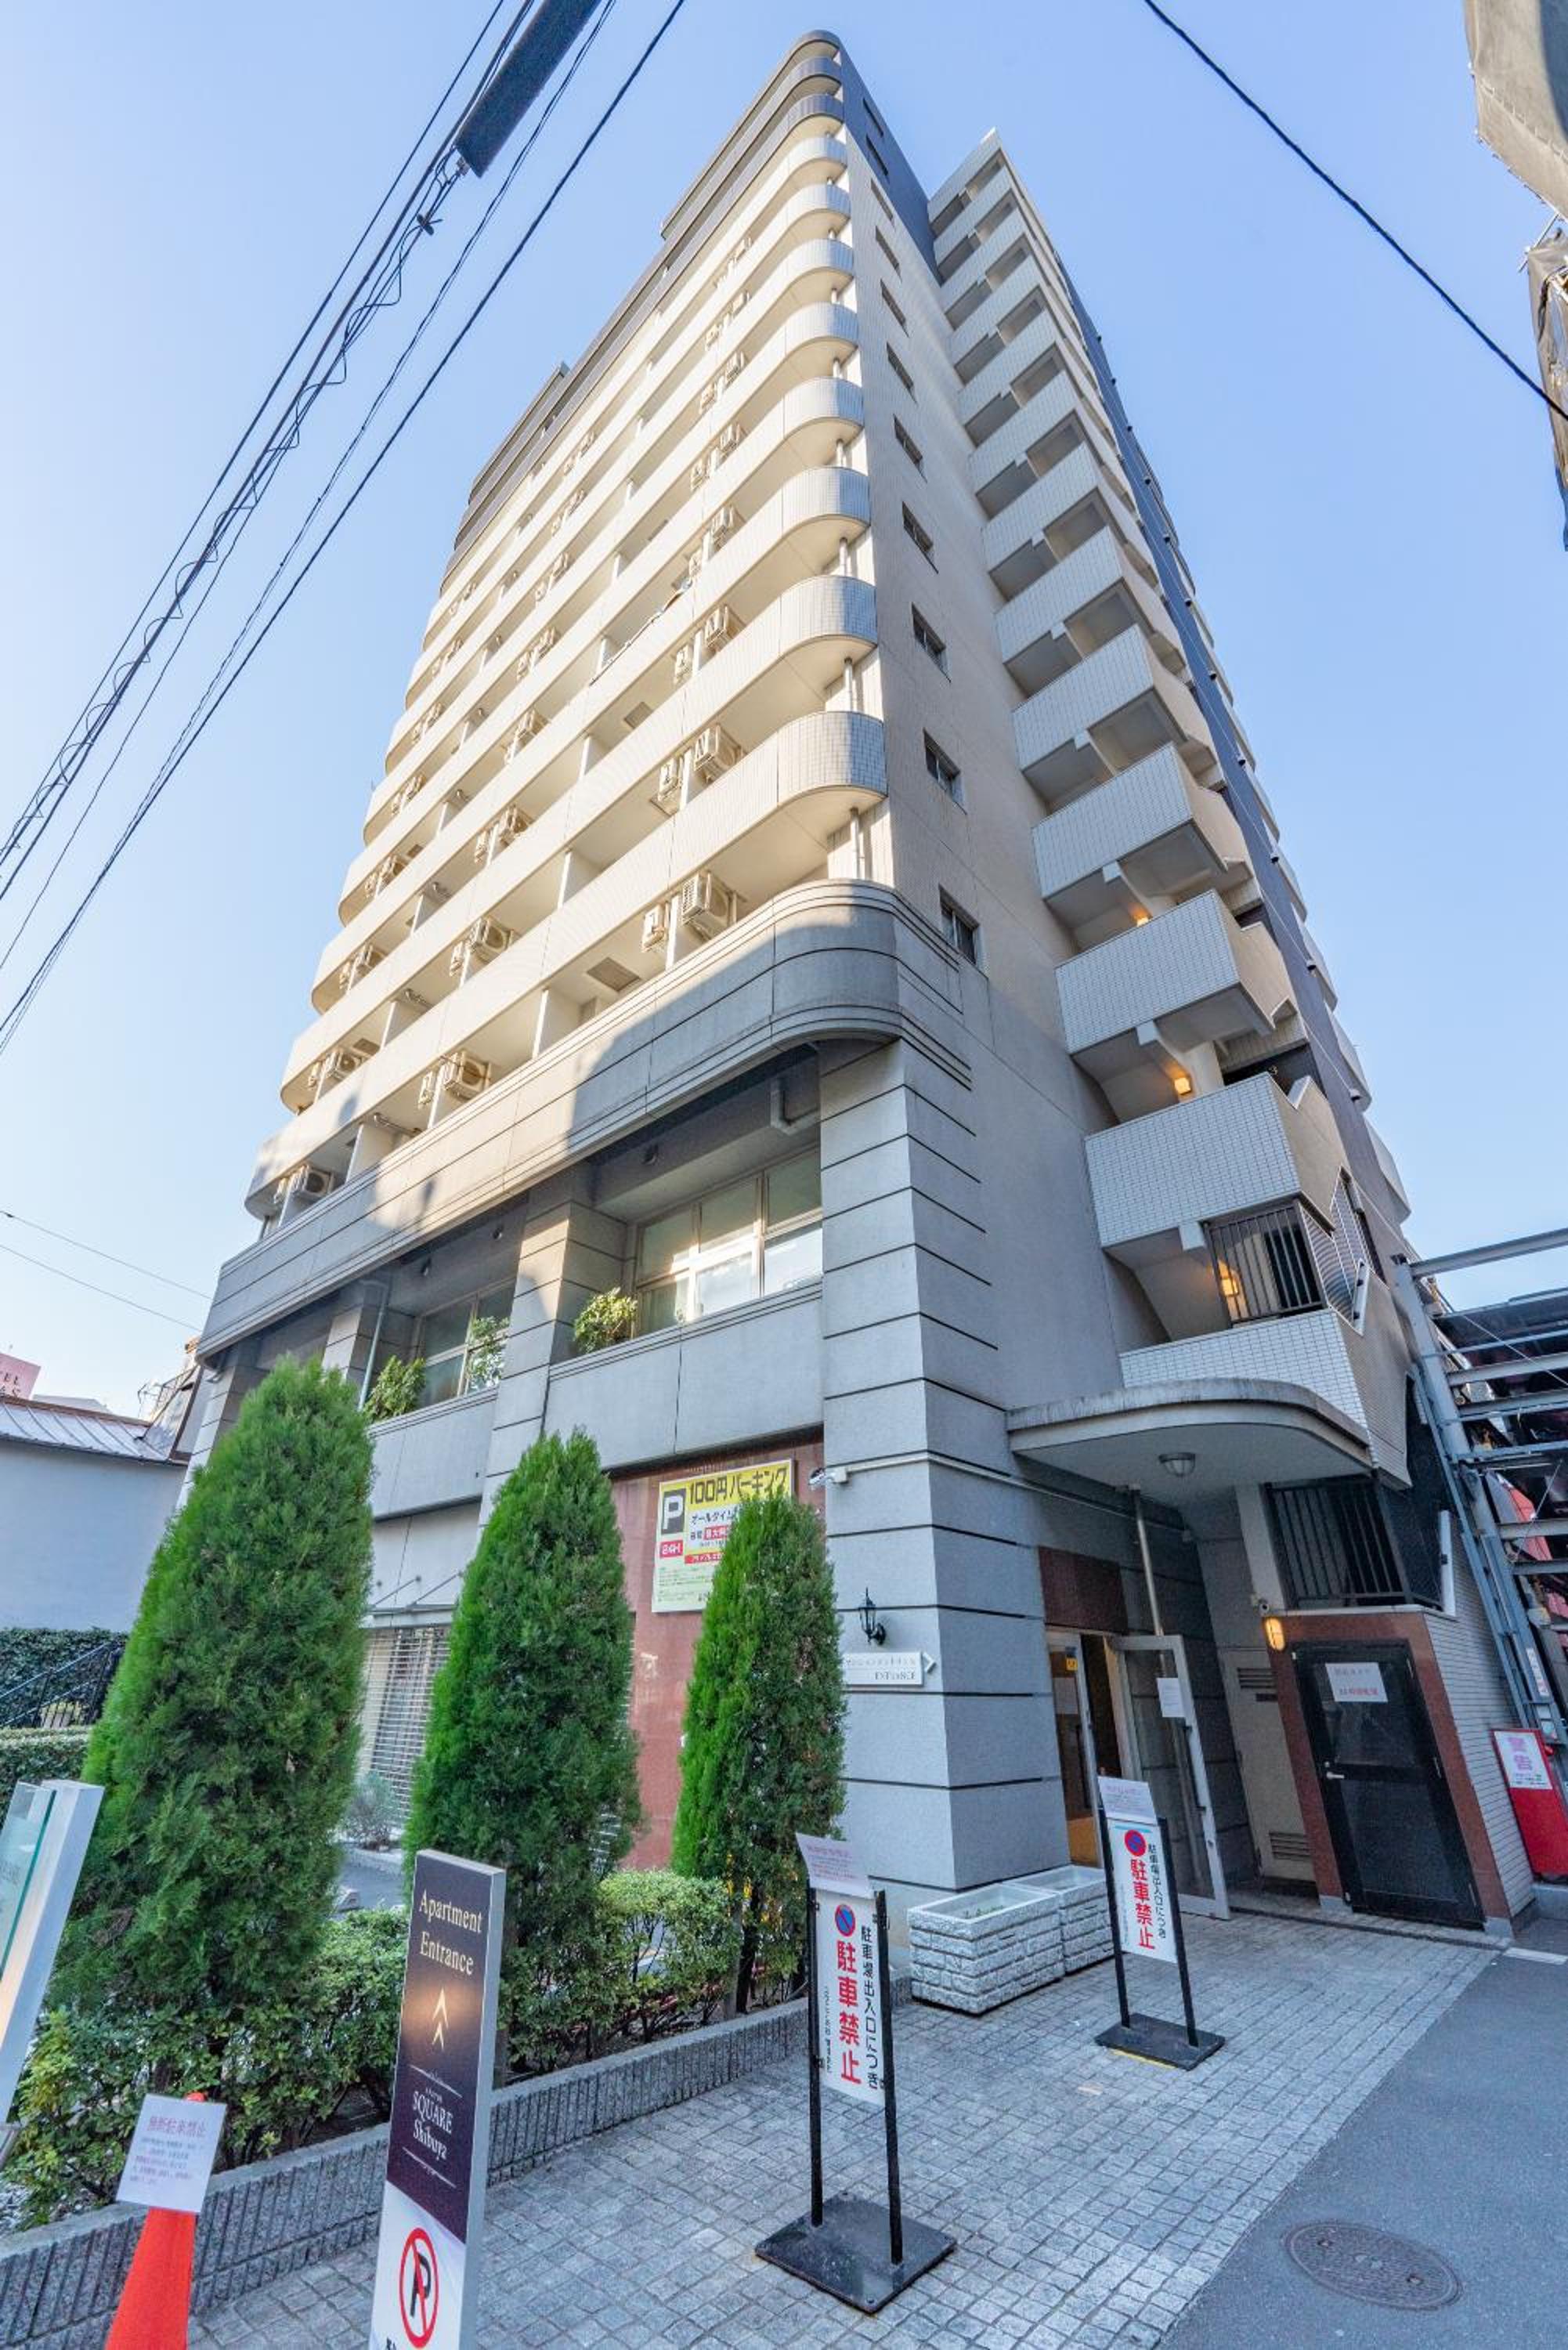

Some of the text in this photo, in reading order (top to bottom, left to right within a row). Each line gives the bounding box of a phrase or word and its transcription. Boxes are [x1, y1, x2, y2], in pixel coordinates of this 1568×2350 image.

[662, 1495, 684, 1530] P
[419, 1889, 482, 1932] Apartment
[1129, 1859, 1155, 1950] 駐車禁止
[420, 1931, 475, 1976] Entrance
[836, 1939, 862, 2085] 駐車禁止
[861, 1925, 878, 2090] 駐車場出入口につき
[413, 2091, 454, 2135] SQUARE
[413, 2118, 448, 2161] Shibuya
